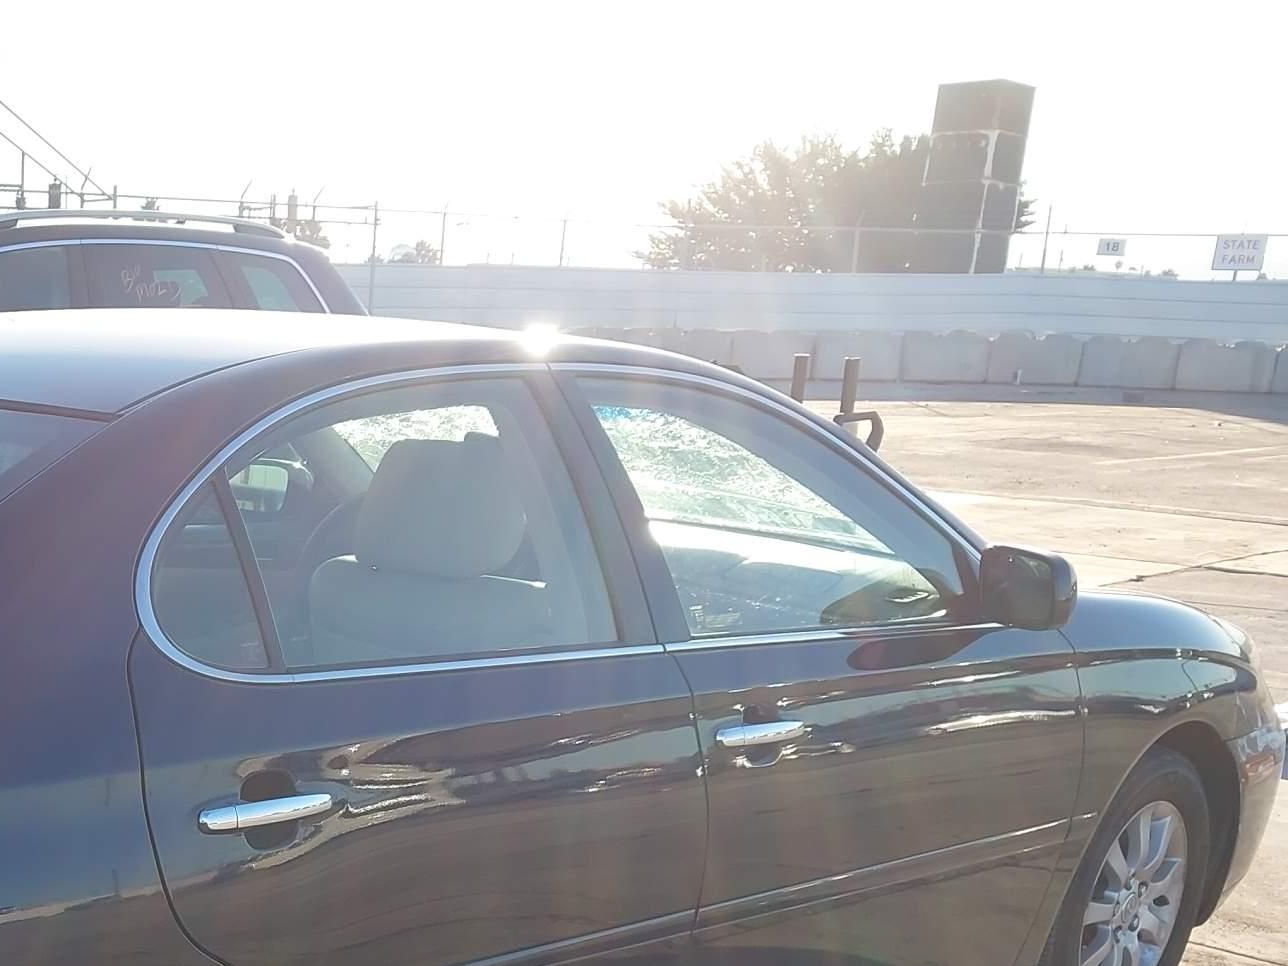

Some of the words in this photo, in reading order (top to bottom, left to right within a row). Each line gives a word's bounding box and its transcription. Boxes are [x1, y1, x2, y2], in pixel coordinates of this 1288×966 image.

[1105, 242, 1120, 252] 18
[1223, 239, 1261, 250] STATE
[1221, 254, 1256, 265] FARM
